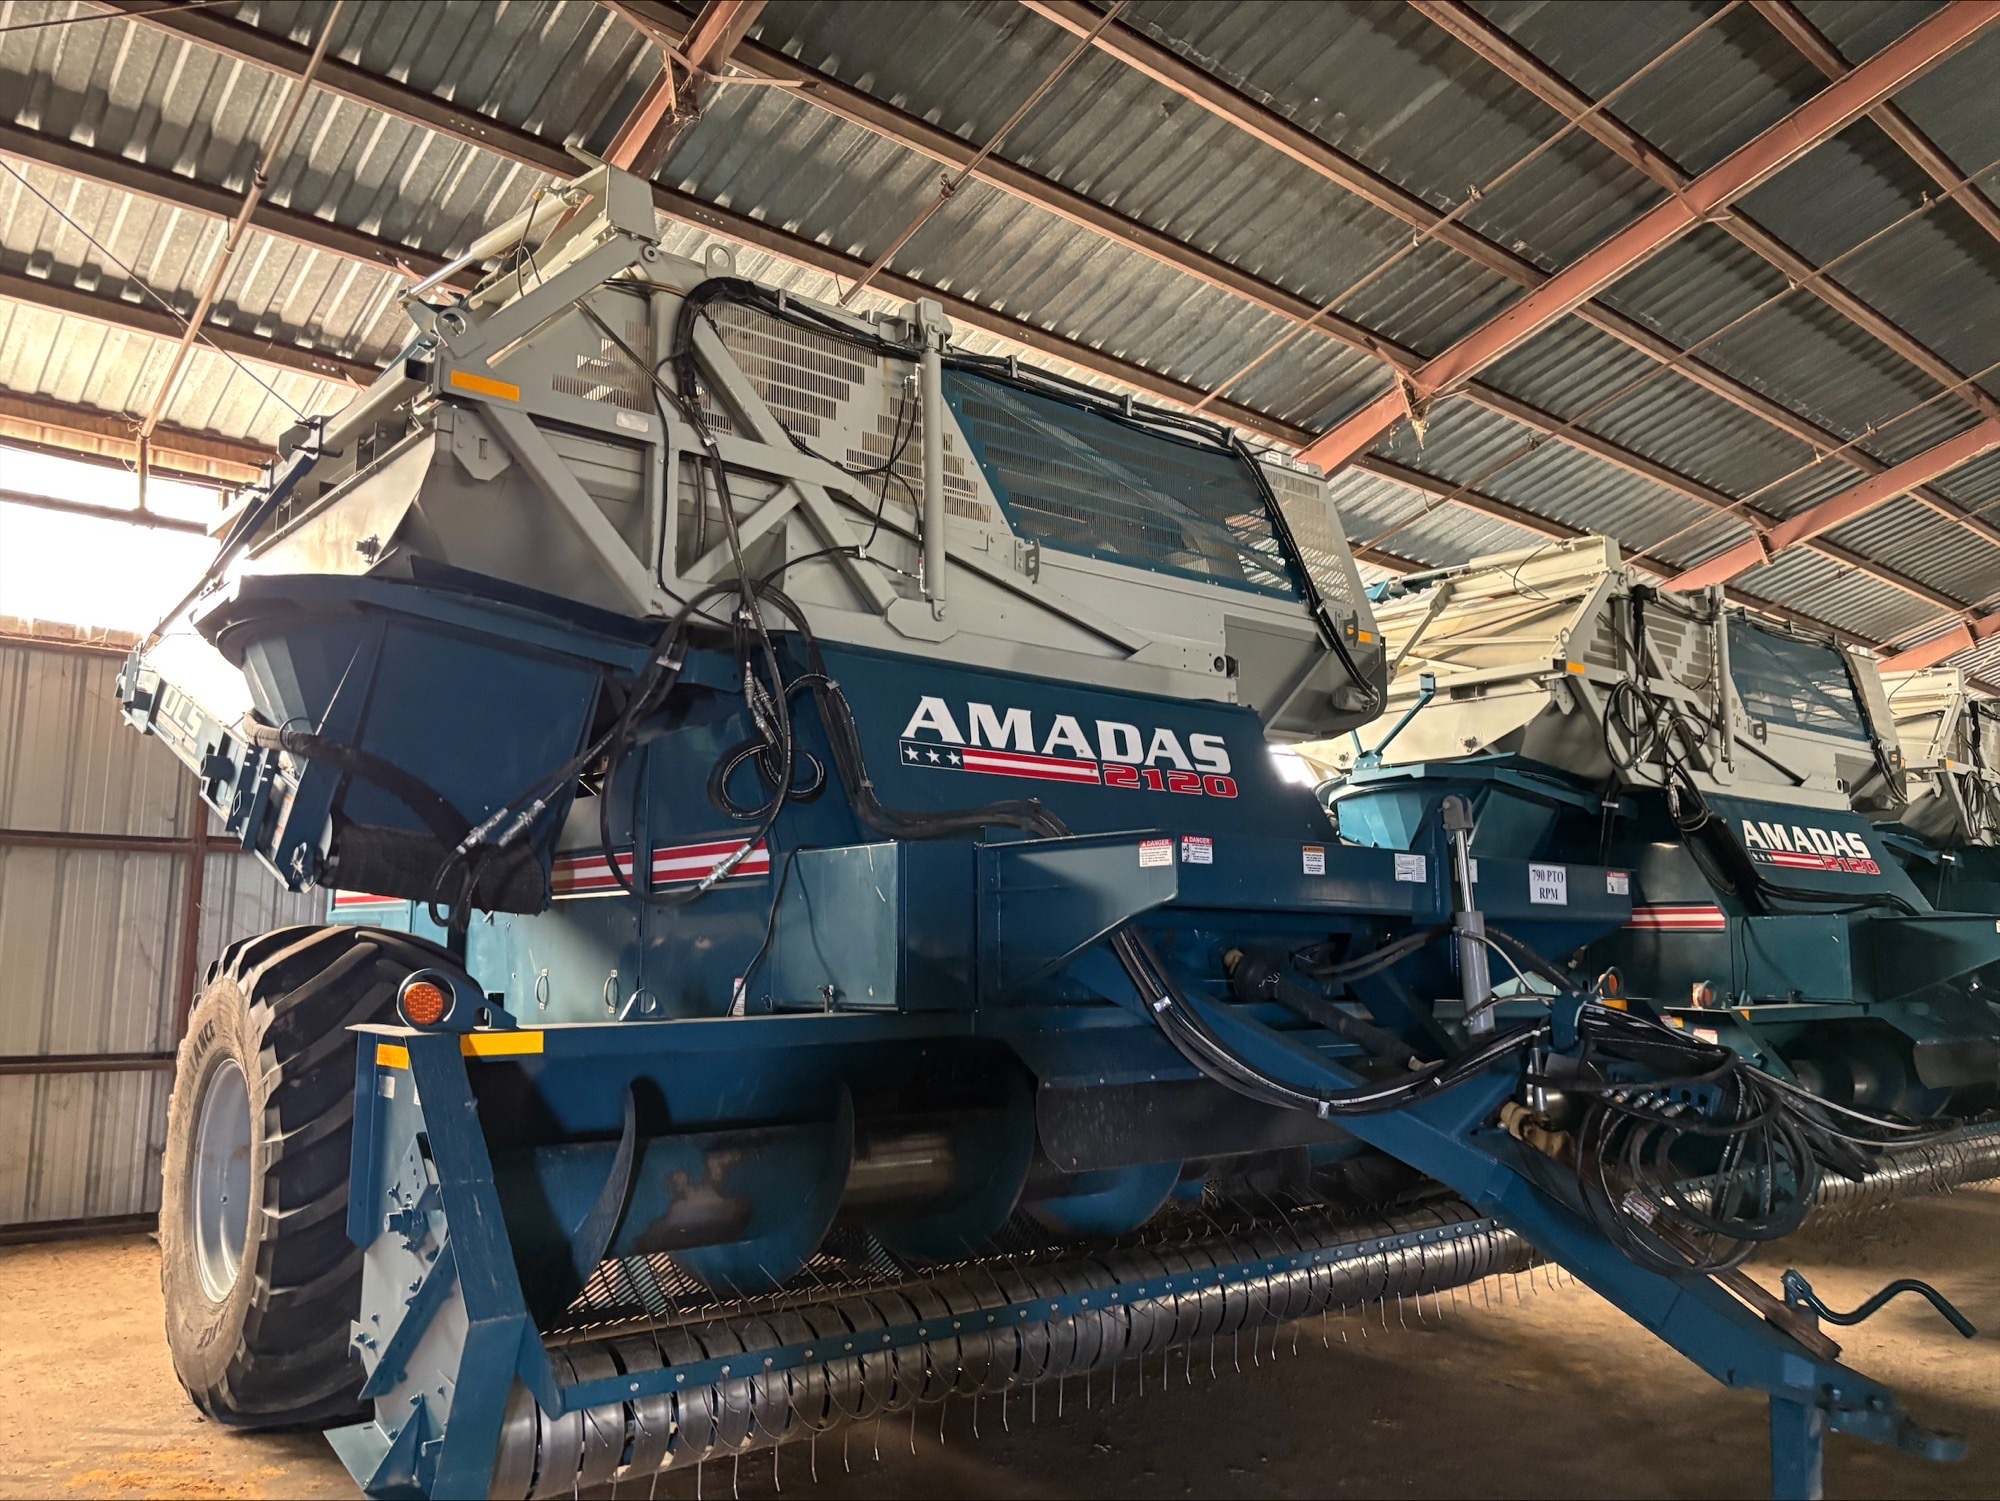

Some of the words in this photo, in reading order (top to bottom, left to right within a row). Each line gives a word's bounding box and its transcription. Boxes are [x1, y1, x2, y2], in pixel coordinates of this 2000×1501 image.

[901, 695, 1231, 773] AMADAS
[1102, 763, 1238, 798] 2120
[1146, 839, 1170, 847] DANGER
[1189, 836, 1211, 844] DANGER
[1741, 820, 1872, 859] AMADAS
[1822, 855, 1881, 875] 2120
[1532, 869, 1545, 882] 790
[1547, 870, 1564, 883] PTO
[1539, 887, 1558, 900] RPM
